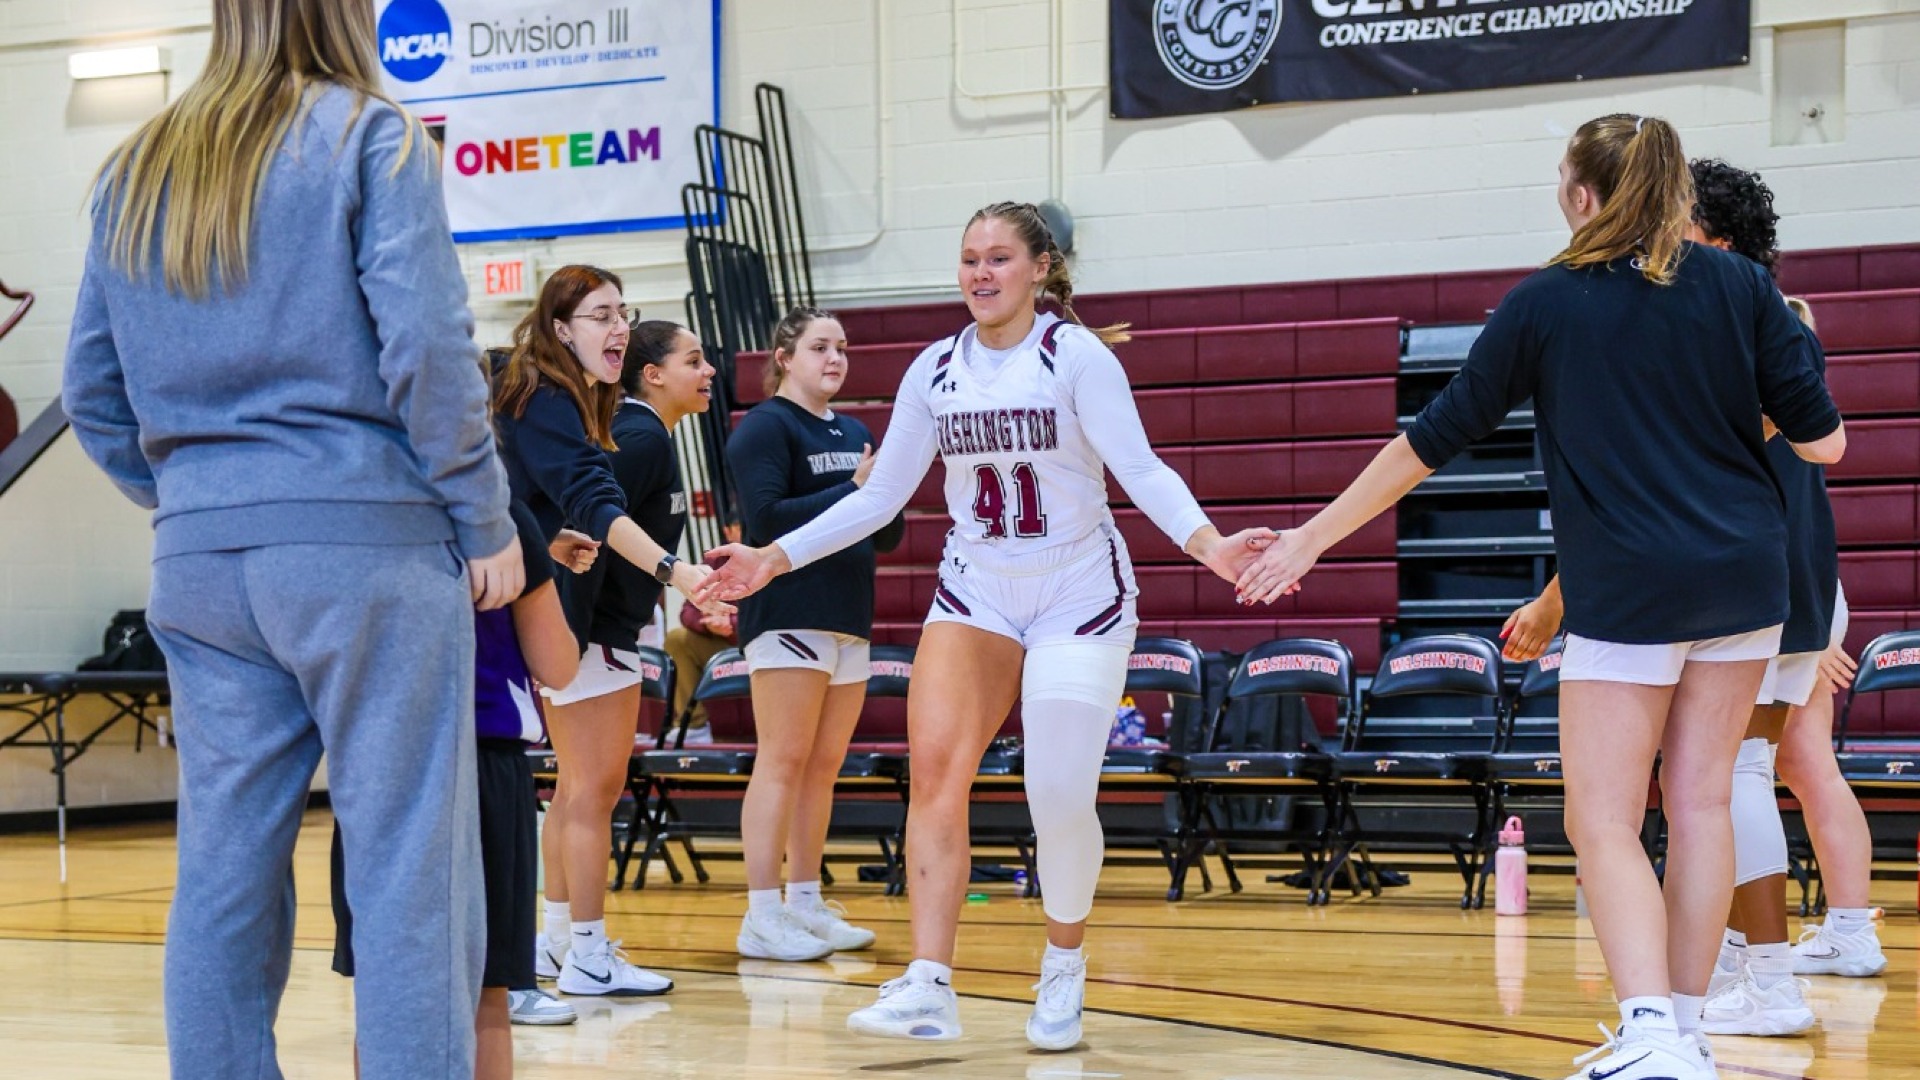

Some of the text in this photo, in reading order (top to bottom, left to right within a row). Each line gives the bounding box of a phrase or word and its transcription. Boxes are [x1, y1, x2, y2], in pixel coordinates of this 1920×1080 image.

[469, 7, 629, 58] Division III
[1320, 13, 1485, 48] CONFERENCE
[1488, 0, 1693, 34] CHAMPIONSHIP
[382, 31, 450, 62] NCAA
[535, 52, 590, 68] DEVELOP
[597, 46, 659, 62] DEDICATE
[1164, 16, 1270, 78] CONFERENCE
[455, 127, 661, 177] ONETEAM
[485, 260, 523, 295] EXIT
[807, 451, 863, 475] WASHIN
[971, 461, 1048, 539] 41
[1128, 653, 1192, 675] HINGTON
[1247, 654, 1339, 677] WASHINGTON
[1389, 651, 1486, 675] WASHINGTON
